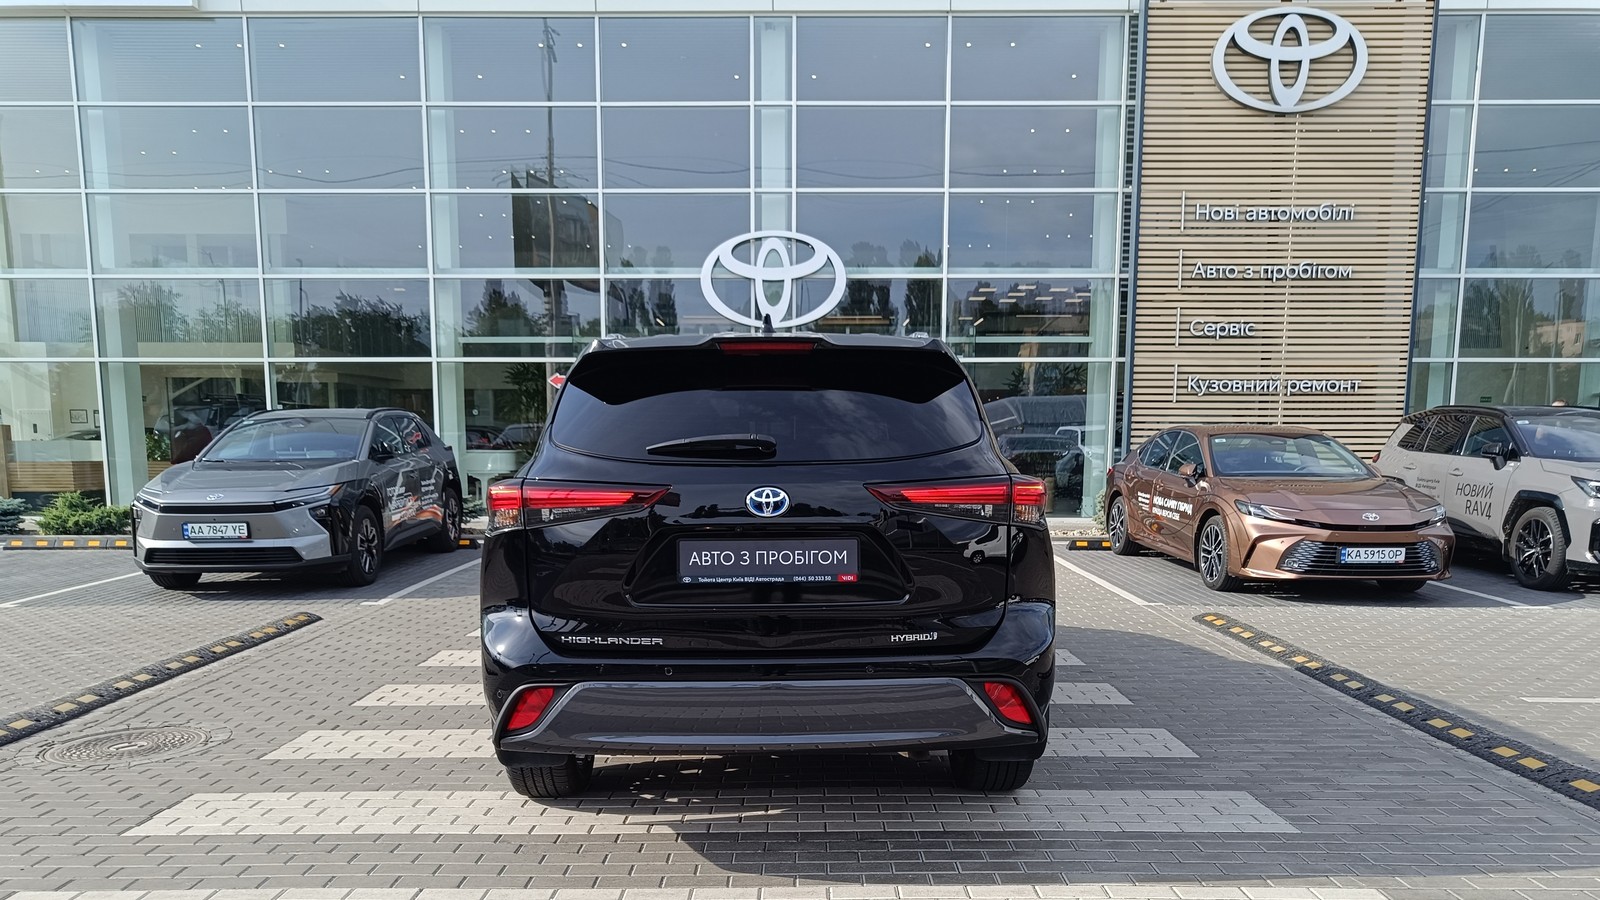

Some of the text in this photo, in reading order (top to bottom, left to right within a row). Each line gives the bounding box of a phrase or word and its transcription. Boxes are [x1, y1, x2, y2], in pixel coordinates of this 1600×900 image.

[1194, 202, 1356, 222] Нові автомобілі
[1191, 260, 1353, 283] Авто з пробігом
[1189, 318, 1257, 340] Сервіс
[1187, 374, 1362, 397] Кузовний ремонт
[1456, 482, 1494, 499] НОВИЙ
[1464, 499, 1492, 520] RAV4
[190, 525, 246, 535] AA 7847 YE
[688, 550, 848, 566] АВТО З ПРОБІГОМ
[1346, 549, 1403, 560] KA 5915 OP
[561, 635, 664, 645] HIGHLANDER
[890, 633, 931, 642] HYBRID
